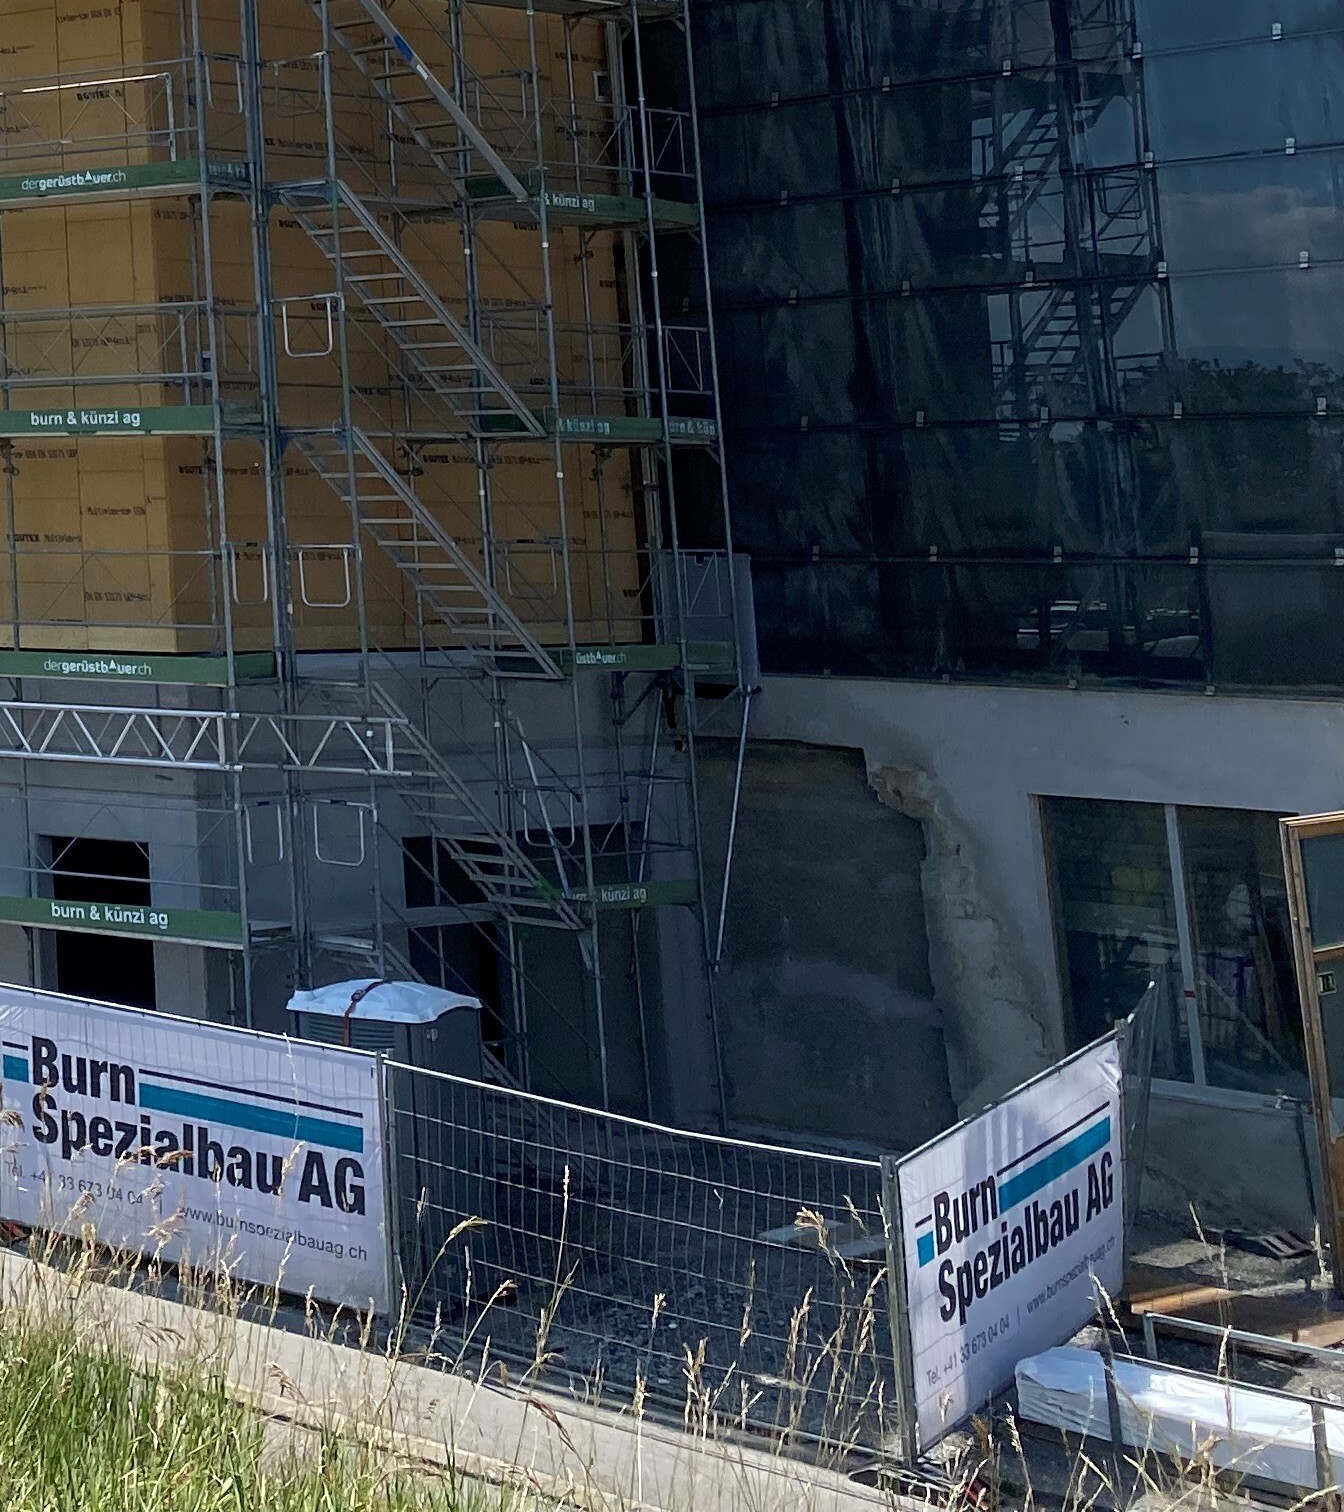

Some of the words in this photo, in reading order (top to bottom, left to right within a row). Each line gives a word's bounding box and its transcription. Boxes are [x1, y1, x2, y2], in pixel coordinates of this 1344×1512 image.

[582, 198, 595, 212] ag
[30, 412, 62, 425] burn
[66, 412, 77, 424] &
[122, 412, 140, 427] ag
[633, 888, 647, 903] ag
[50, 902, 85, 919] burn
[89, 905, 101, 921] &
[148, 912, 168, 930] ag
[31, 1035, 136, 1106] Burn
[32, 1090, 284, 1197] Spezialbau
[298, 1149, 367, 1218] AG
[932, 1173, 998, 1259] Burn
[938, 1190, 1079, 1326] Spezialbau
[1086, 1150, 1114, 1225] AG
[926, 1363, 942, 1387] Tel.
